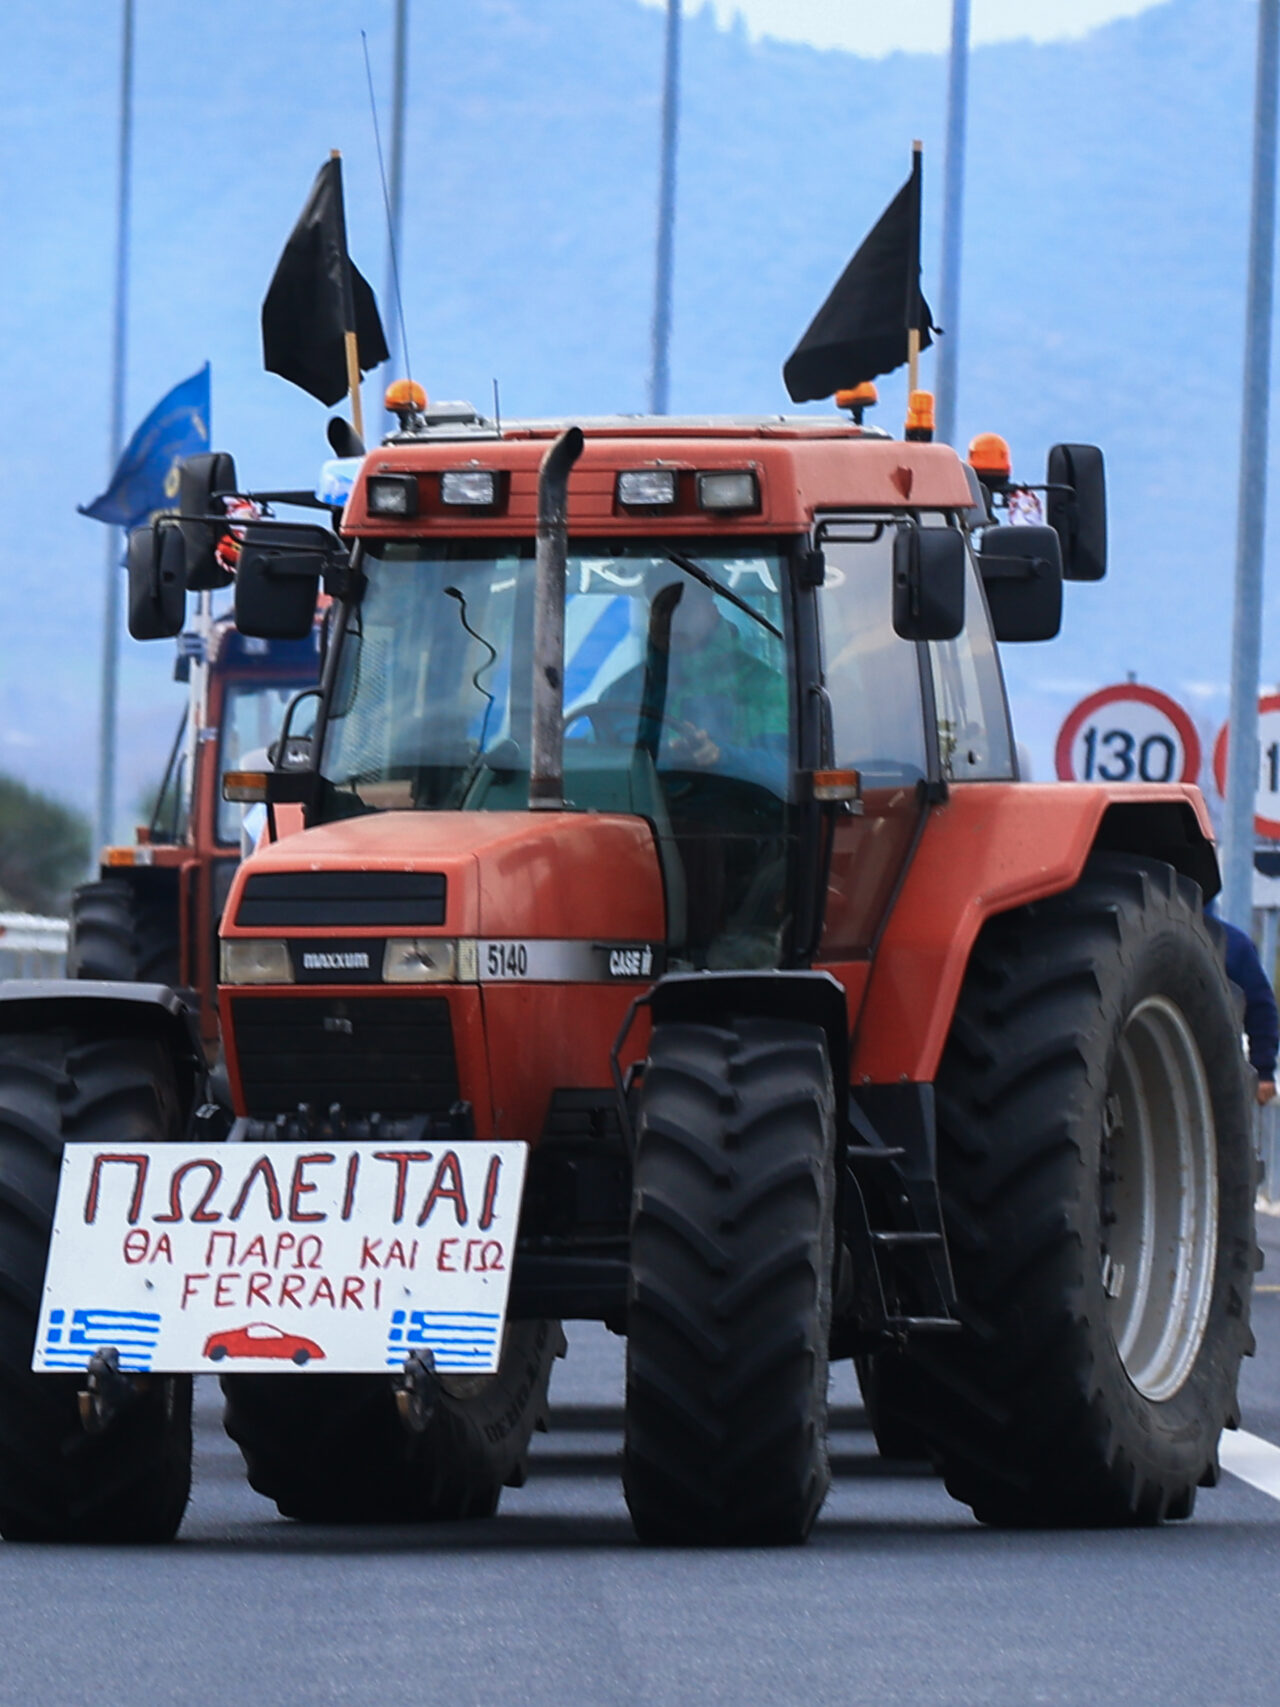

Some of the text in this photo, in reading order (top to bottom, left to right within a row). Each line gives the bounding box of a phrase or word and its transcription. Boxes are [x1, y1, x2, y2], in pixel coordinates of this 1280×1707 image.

[1083, 726, 1176, 782] 130
[487, 943, 528, 976] 5140
[609, 949, 641, 976] CASE
[83, 1149, 503, 1232] ΠΩΛΕΙΤΑΙ
[122, 1228, 507, 1273] ΘΑ ΠΑΡΩ ΚΑΙ ΕΓΩ
[179, 1271, 383, 1311] FERRARI
